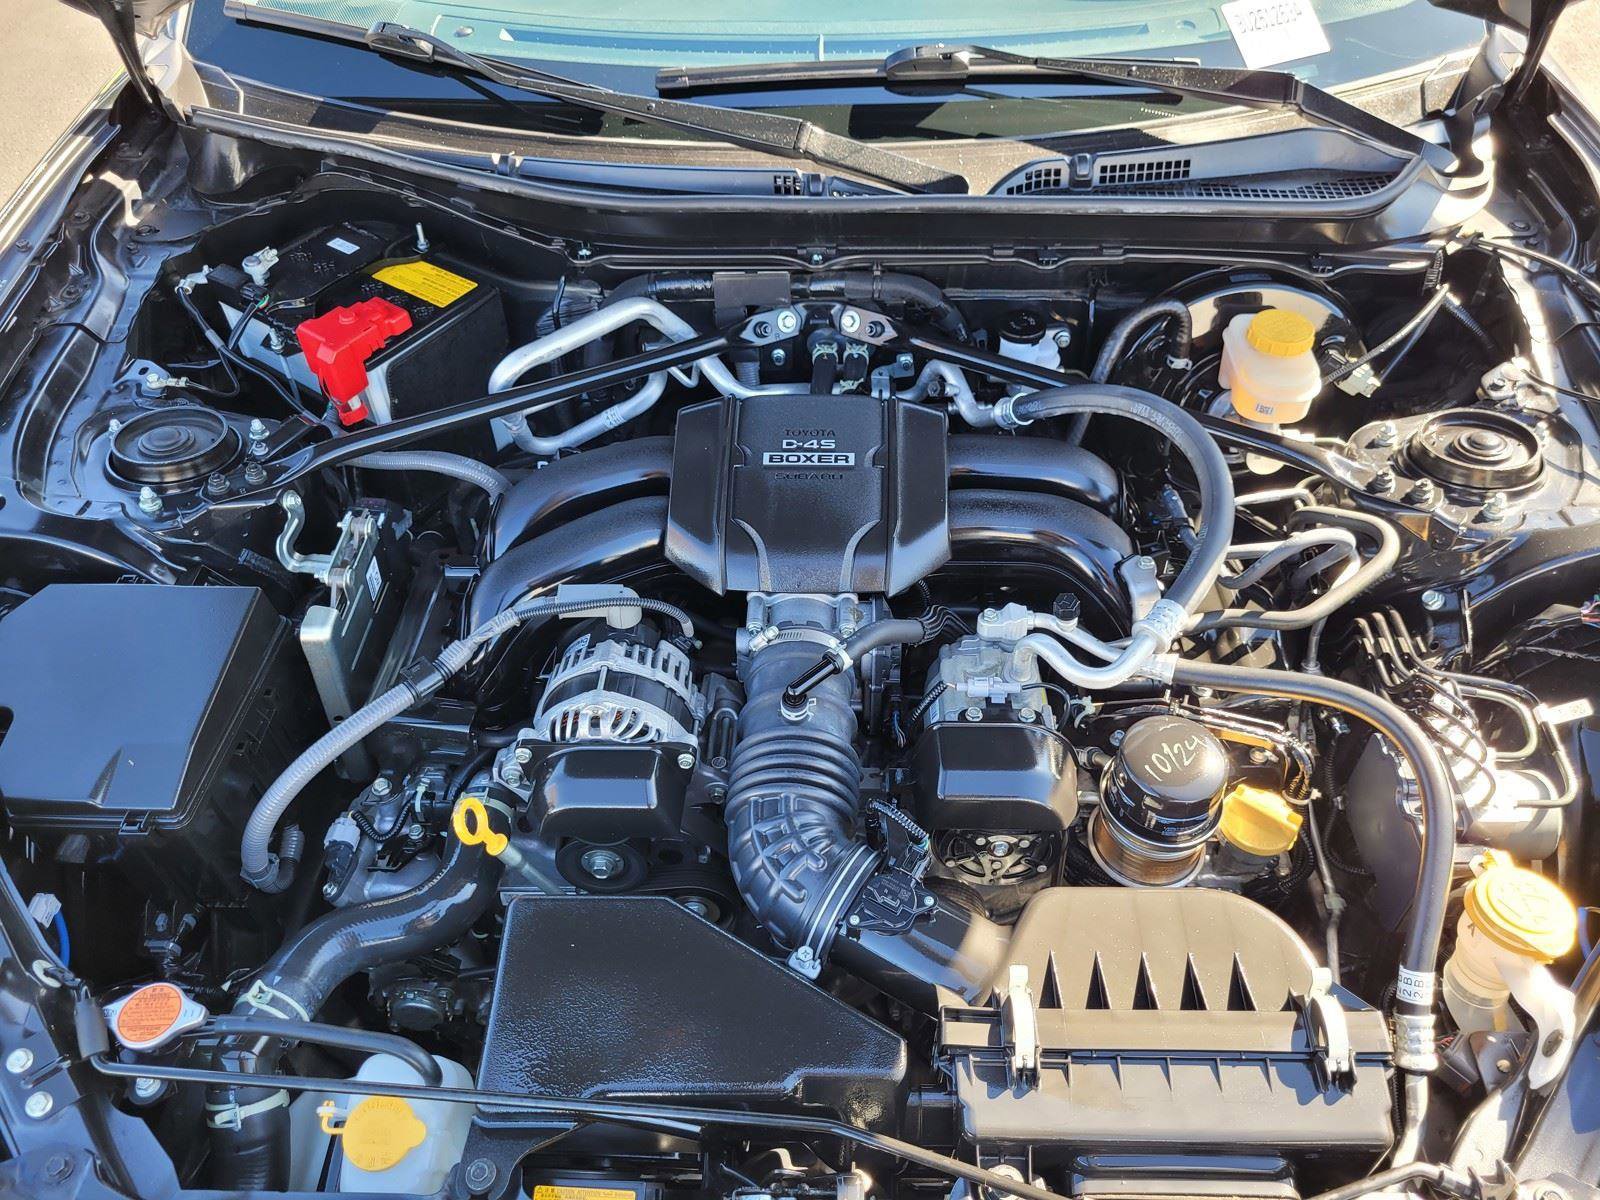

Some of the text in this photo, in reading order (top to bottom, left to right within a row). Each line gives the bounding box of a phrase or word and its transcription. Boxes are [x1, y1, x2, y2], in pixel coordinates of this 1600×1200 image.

[785, 429, 836, 437] TOYOTA
[768, 454, 850, 464] BOXER
[774, 472, 844, 480] SUBARU
